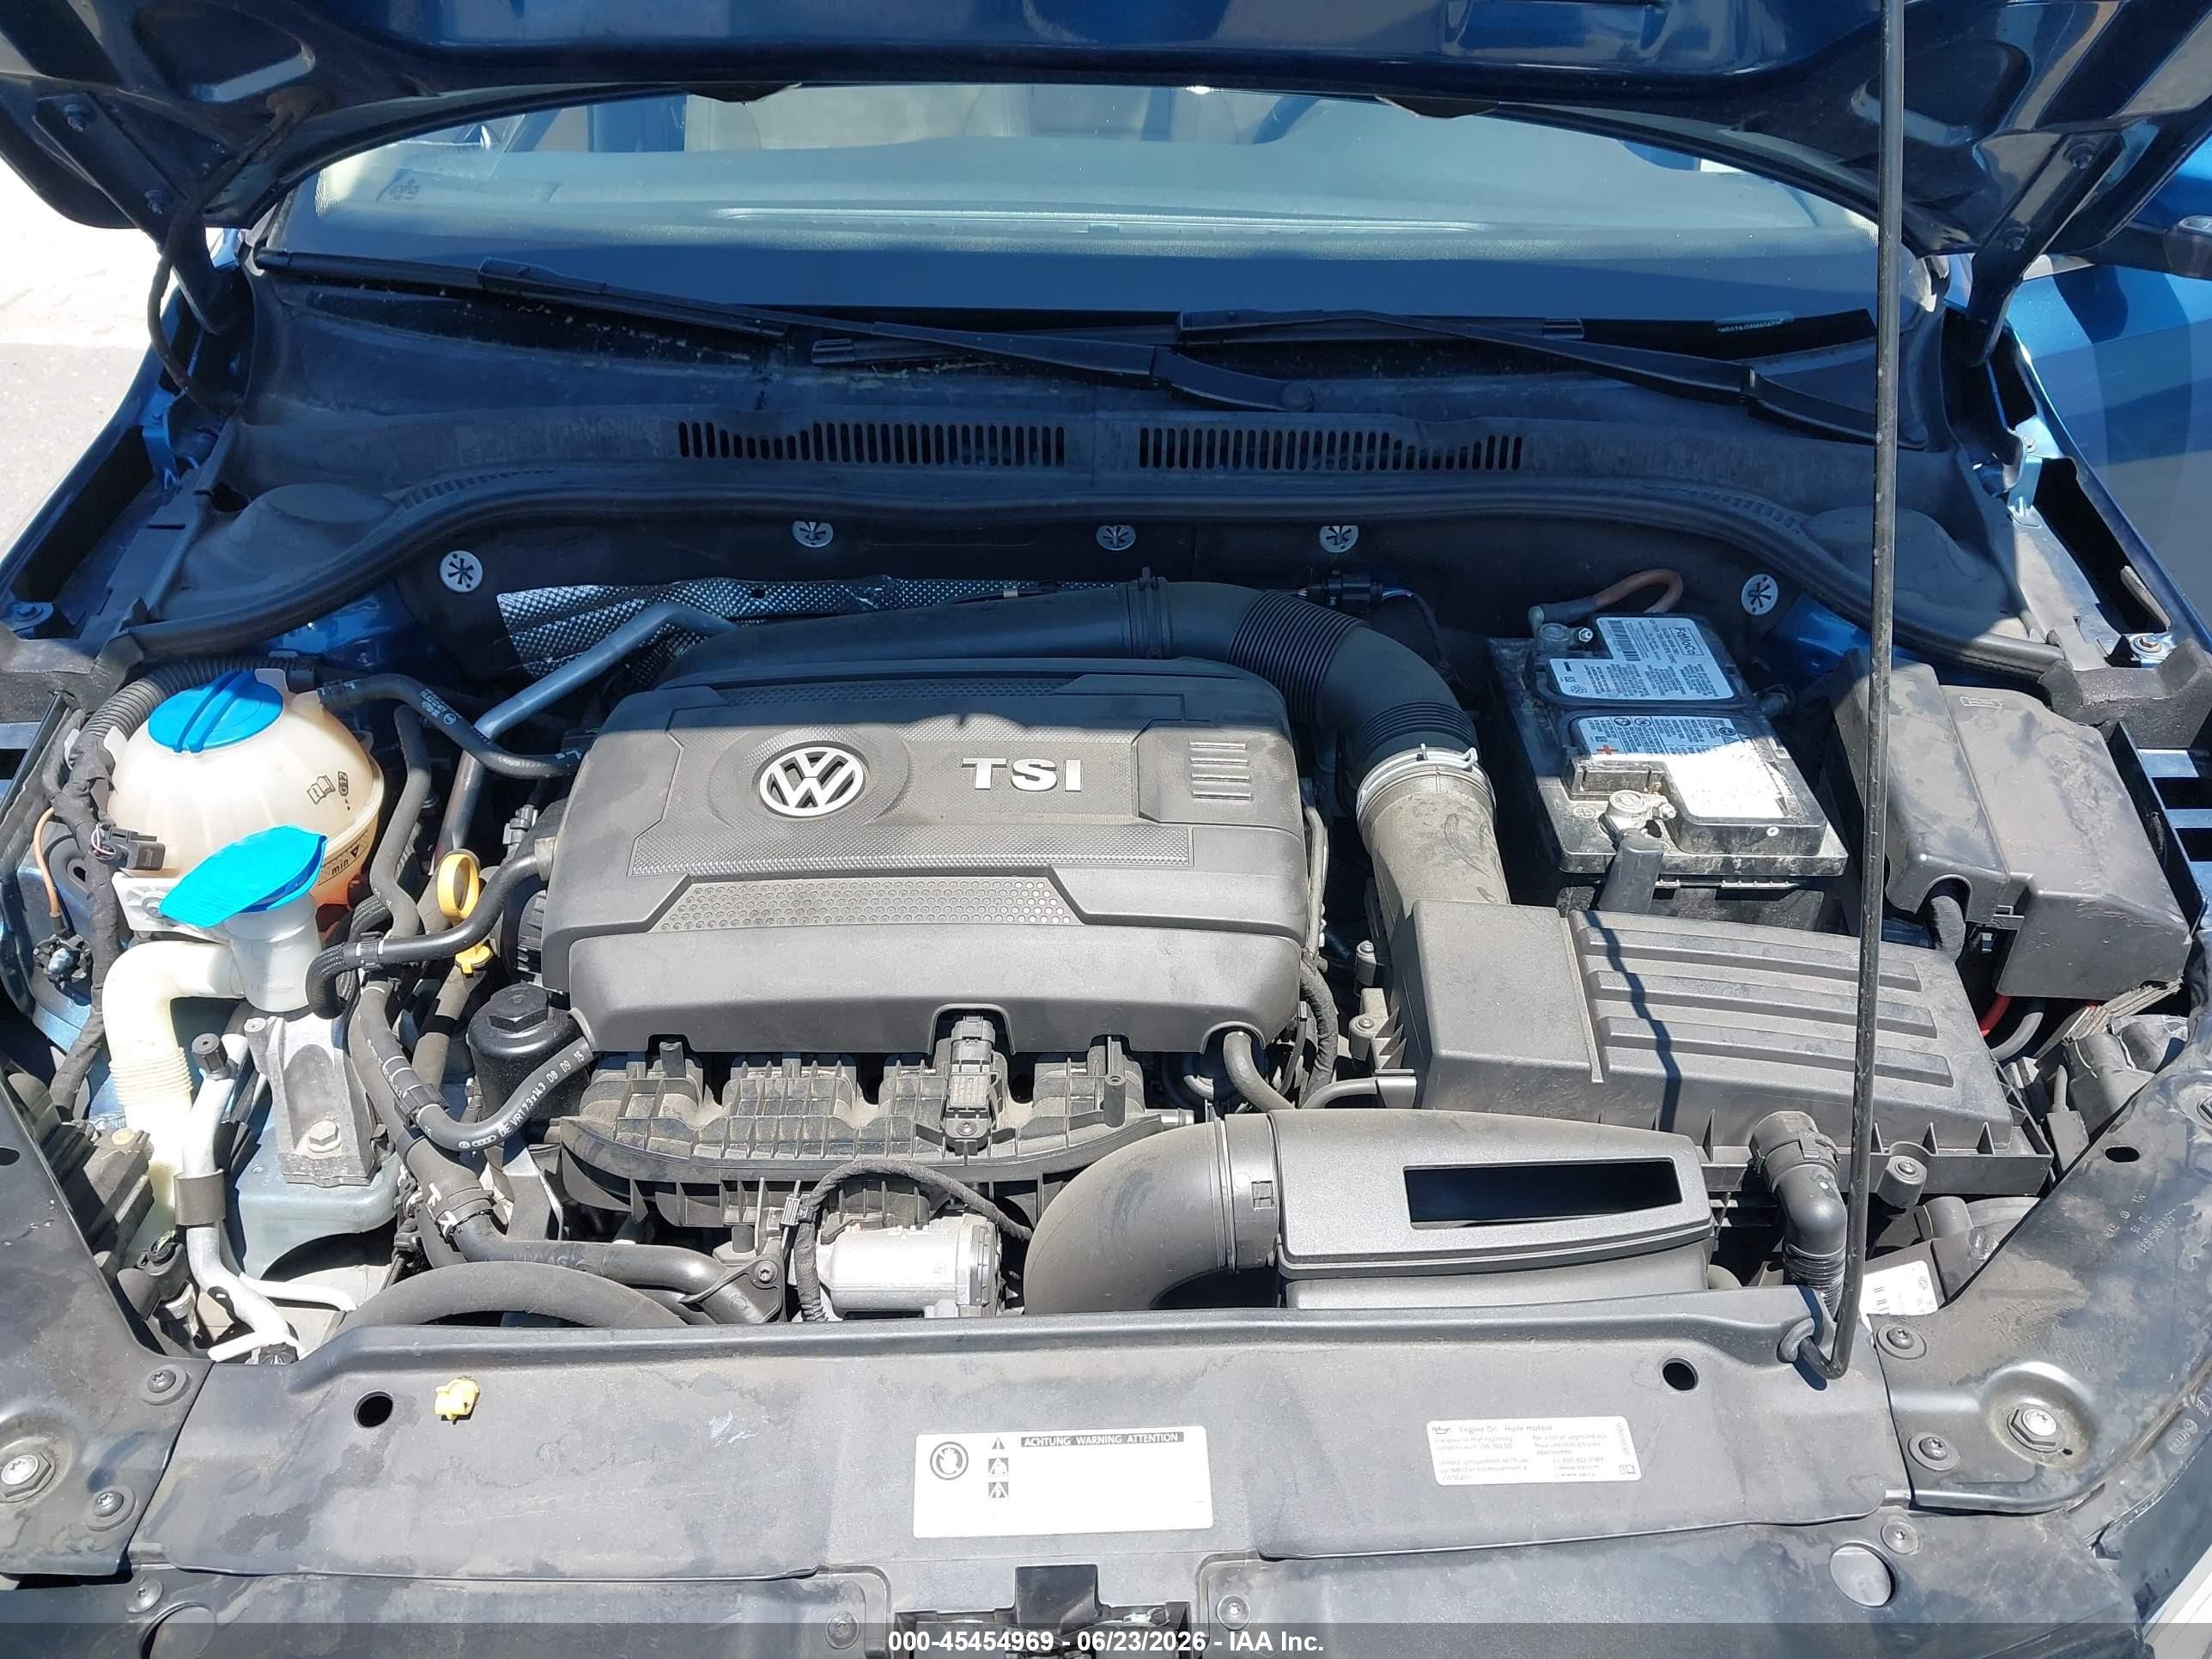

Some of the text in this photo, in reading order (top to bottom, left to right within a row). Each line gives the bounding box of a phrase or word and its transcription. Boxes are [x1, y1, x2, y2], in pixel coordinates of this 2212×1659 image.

[962, 757, 1083, 793] TSI
[331, 859, 349, 875] min
[509, 1109, 526, 1126] VRT
[574, 1050, 585, 1064] 15
[1459, 1426, 1485, 1435] Engine
[1024, 1433, 1179, 1447] ACHTUNG WARNING ATTENTION
